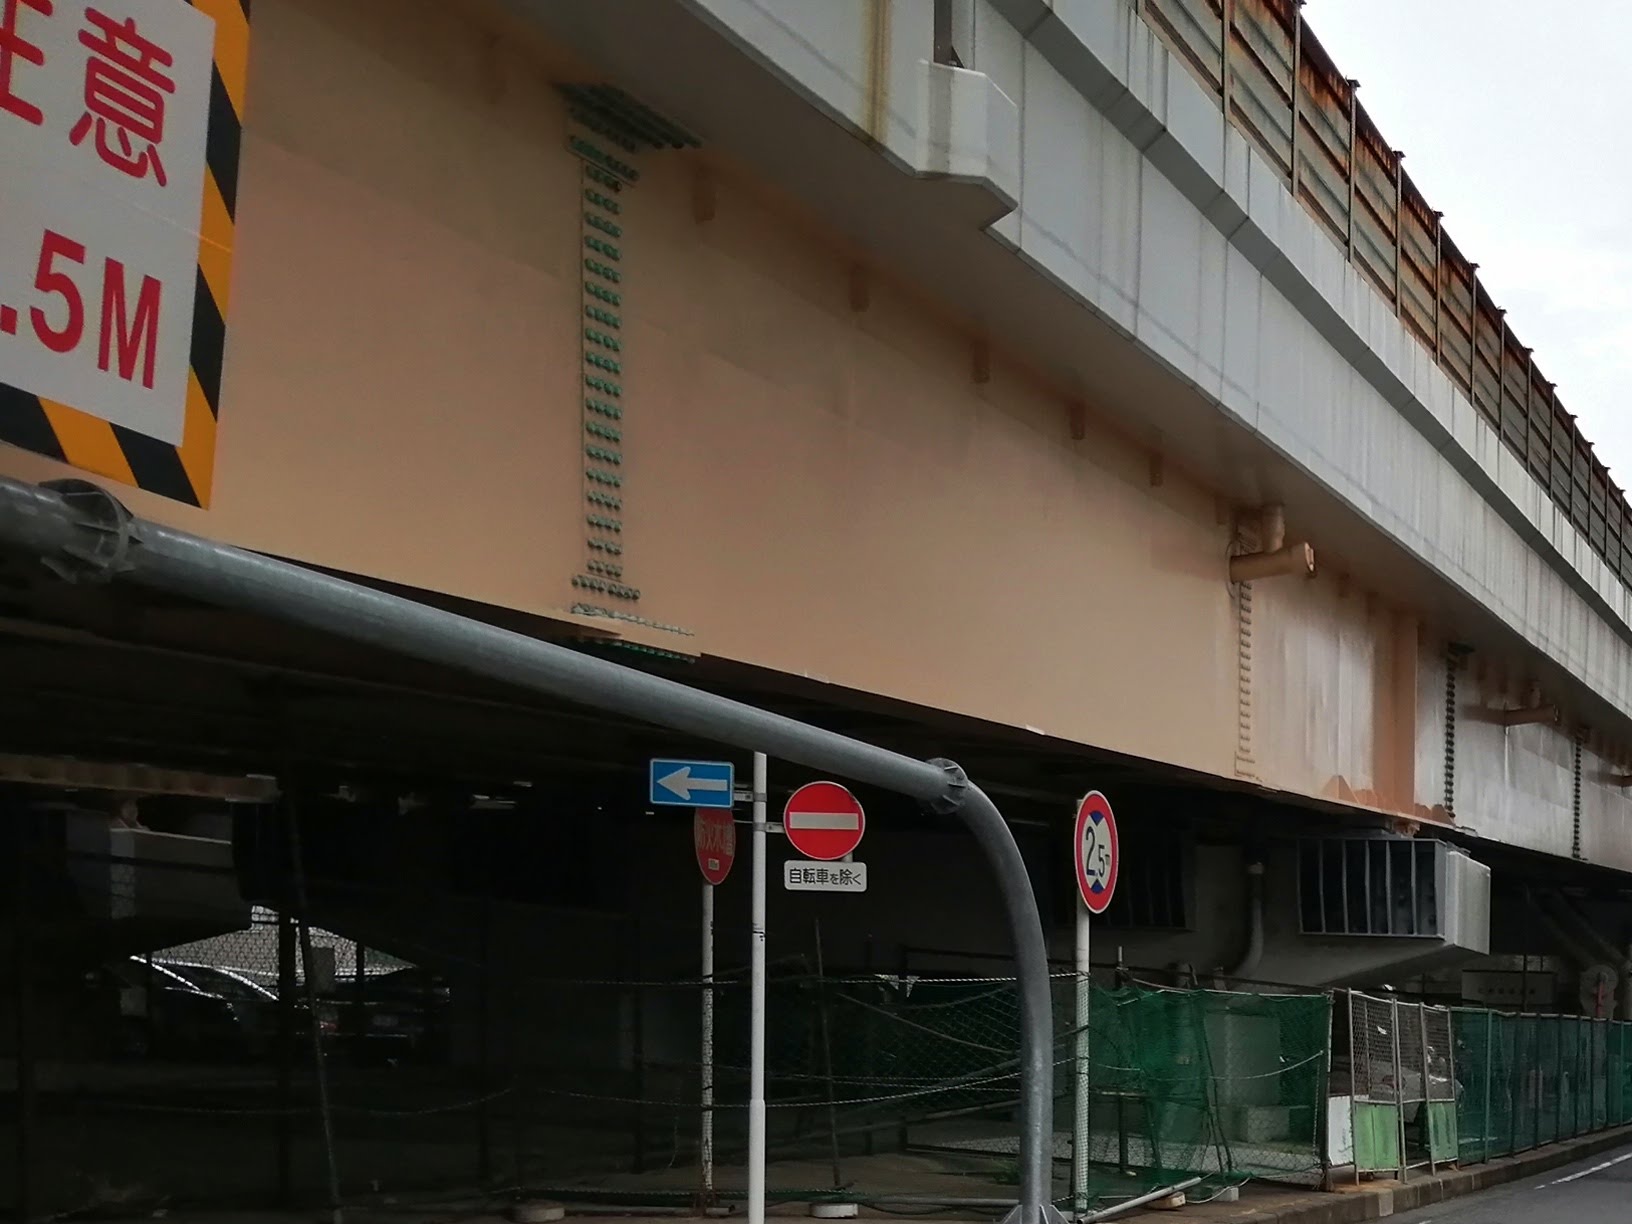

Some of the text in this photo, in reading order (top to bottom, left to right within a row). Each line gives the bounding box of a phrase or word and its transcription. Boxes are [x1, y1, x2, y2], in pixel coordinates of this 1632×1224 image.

[790, 868, 862, 886] 自転車を除く
